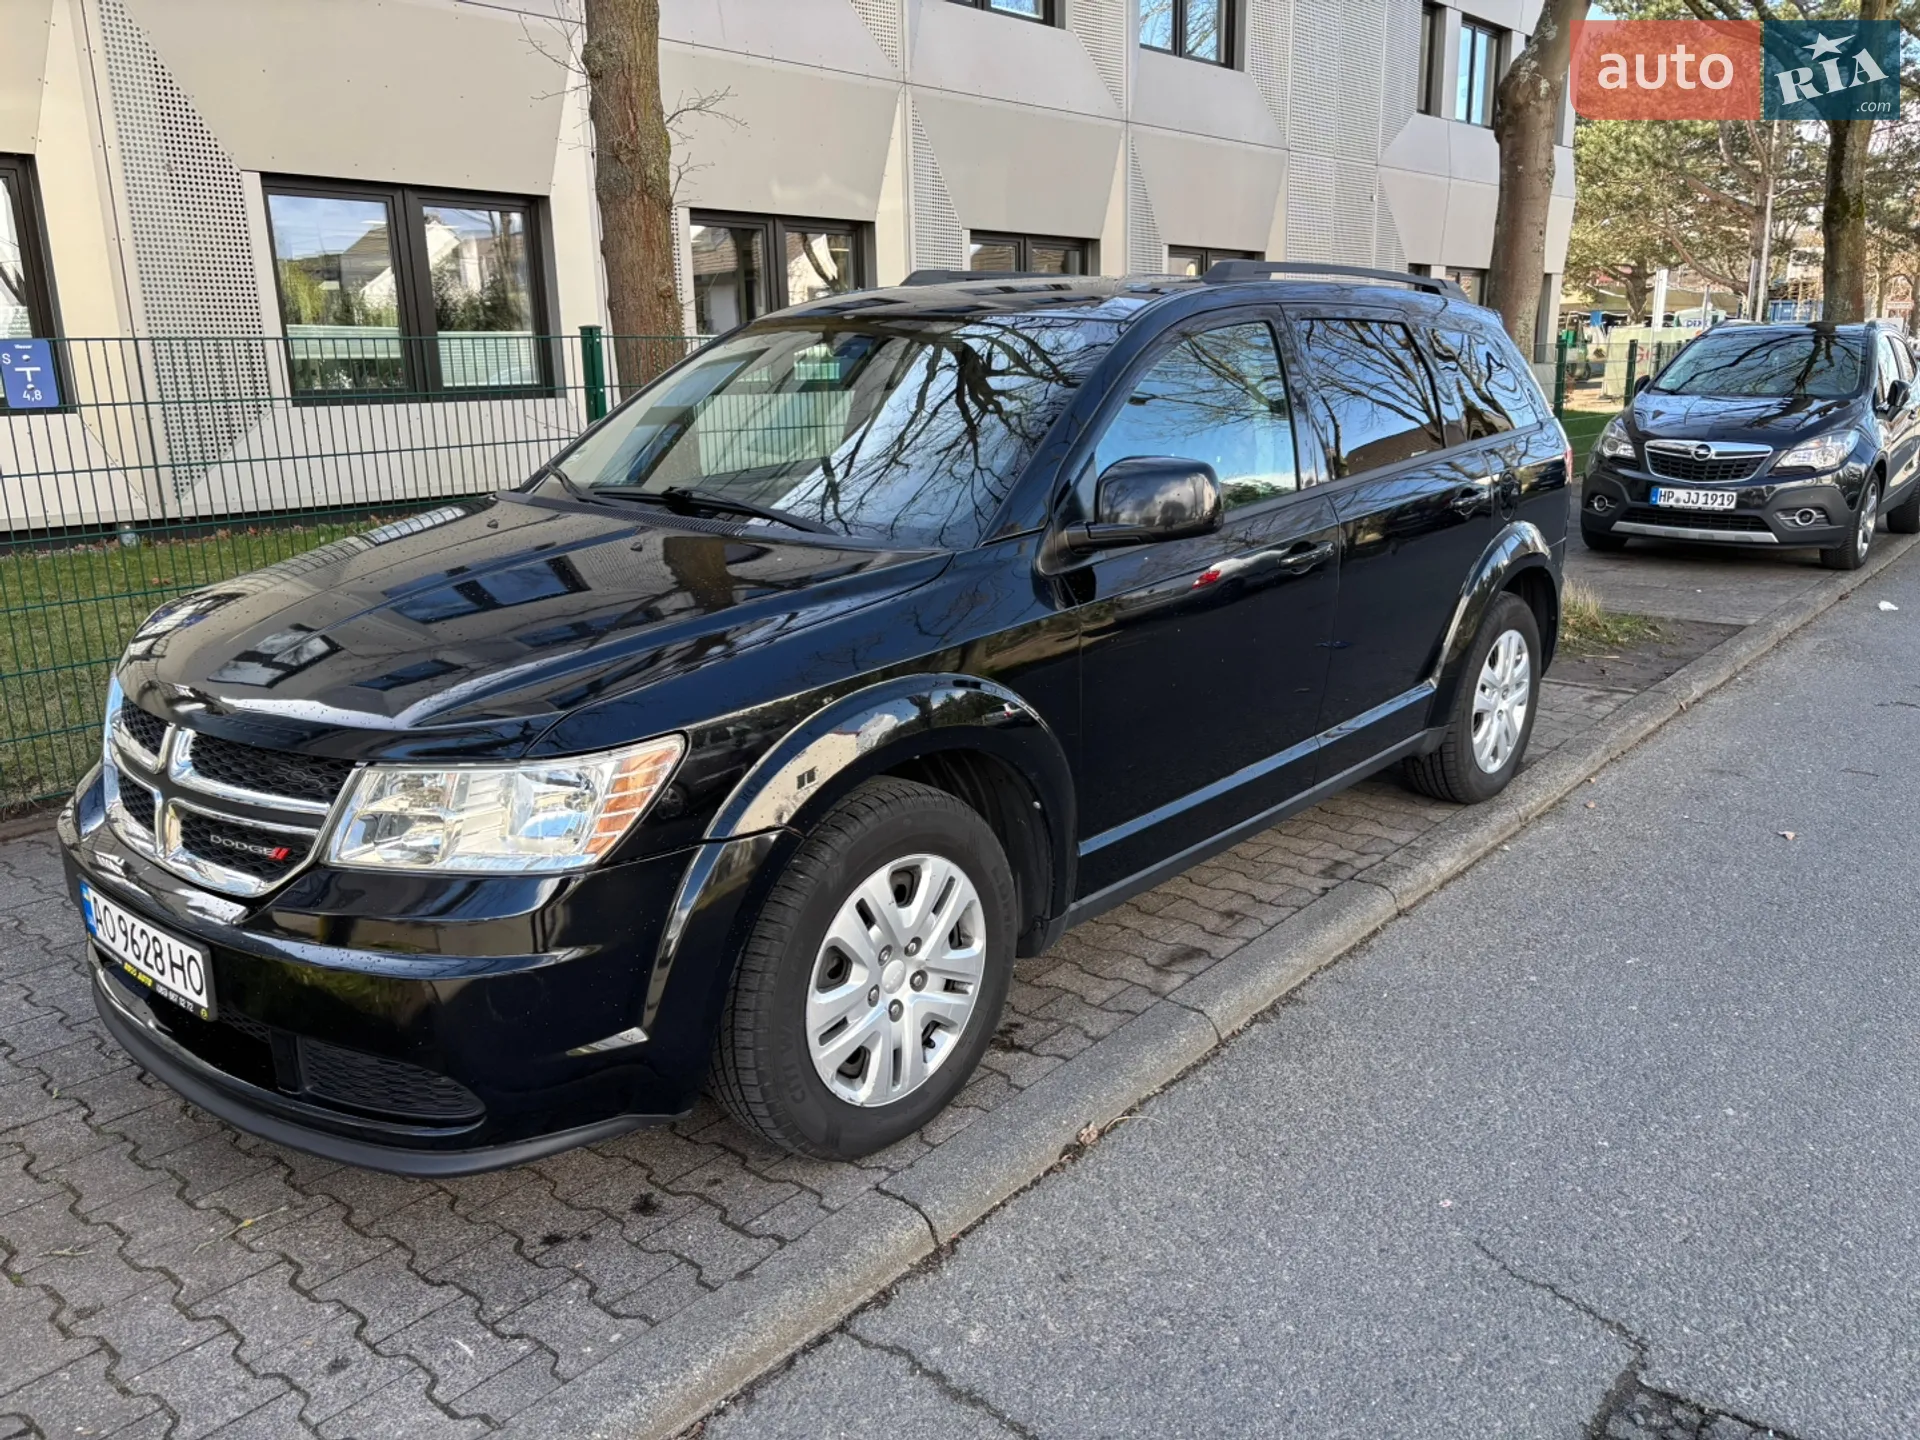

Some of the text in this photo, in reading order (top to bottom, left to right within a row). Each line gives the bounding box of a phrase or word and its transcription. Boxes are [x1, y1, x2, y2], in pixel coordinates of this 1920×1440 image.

[2, 353, 11, 365] S
[22, 389, 42, 402] 4,8
[1658, 490, 1735, 507] HP JJ 1919
[210, 834, 273, 856] DODGE
